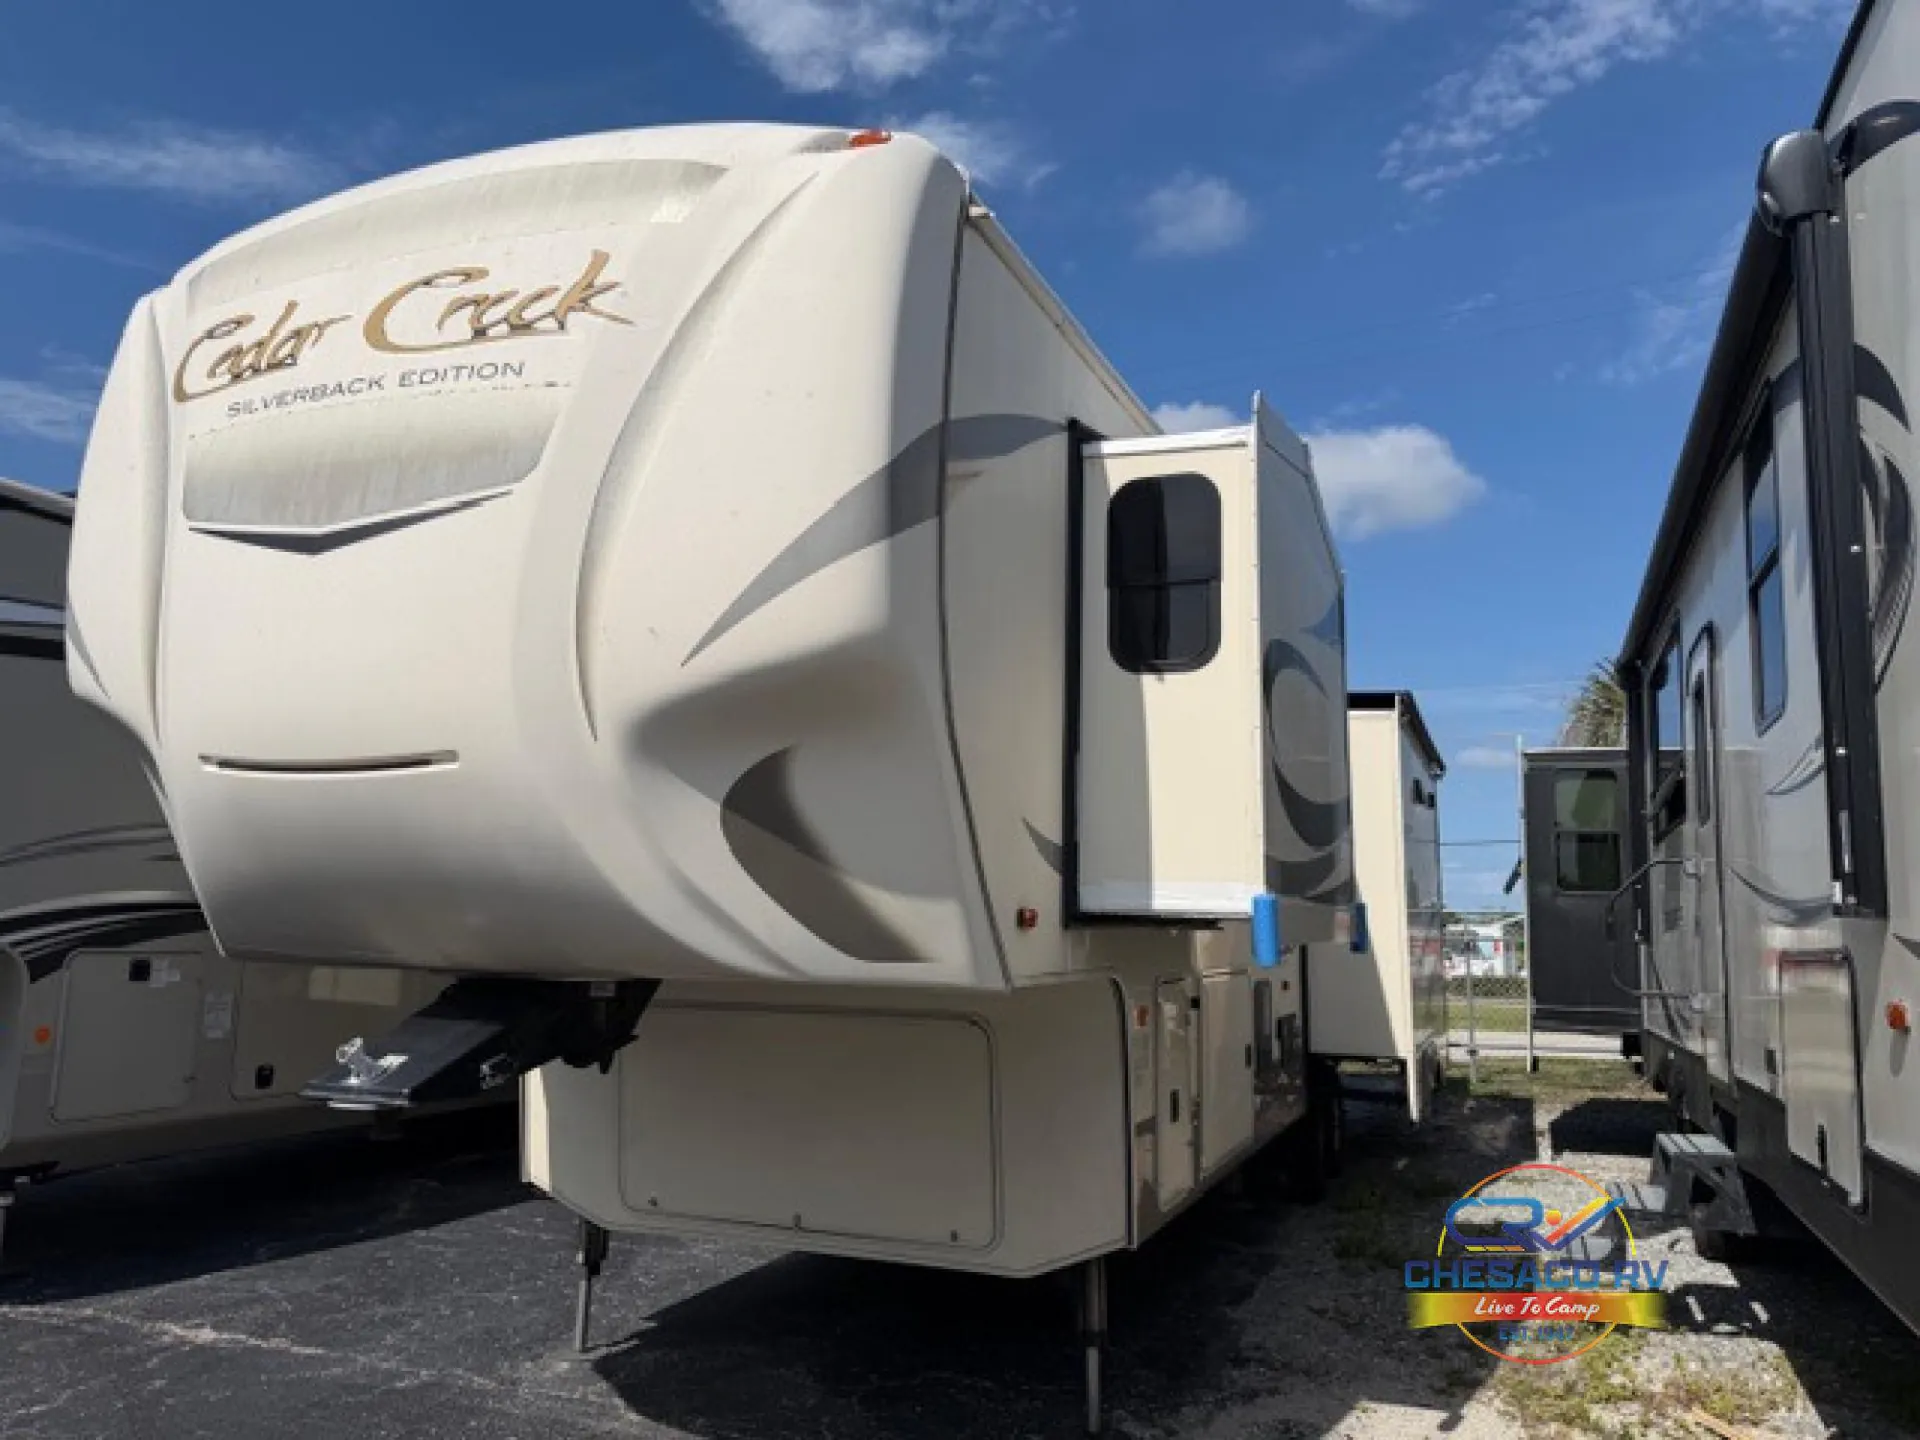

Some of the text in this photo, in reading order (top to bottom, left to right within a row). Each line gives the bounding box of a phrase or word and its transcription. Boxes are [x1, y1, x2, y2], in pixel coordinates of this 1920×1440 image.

[173, 249, 636, 403] Cedar Creek
[226, 361, 526, 418] SILVERBACK EDITION
